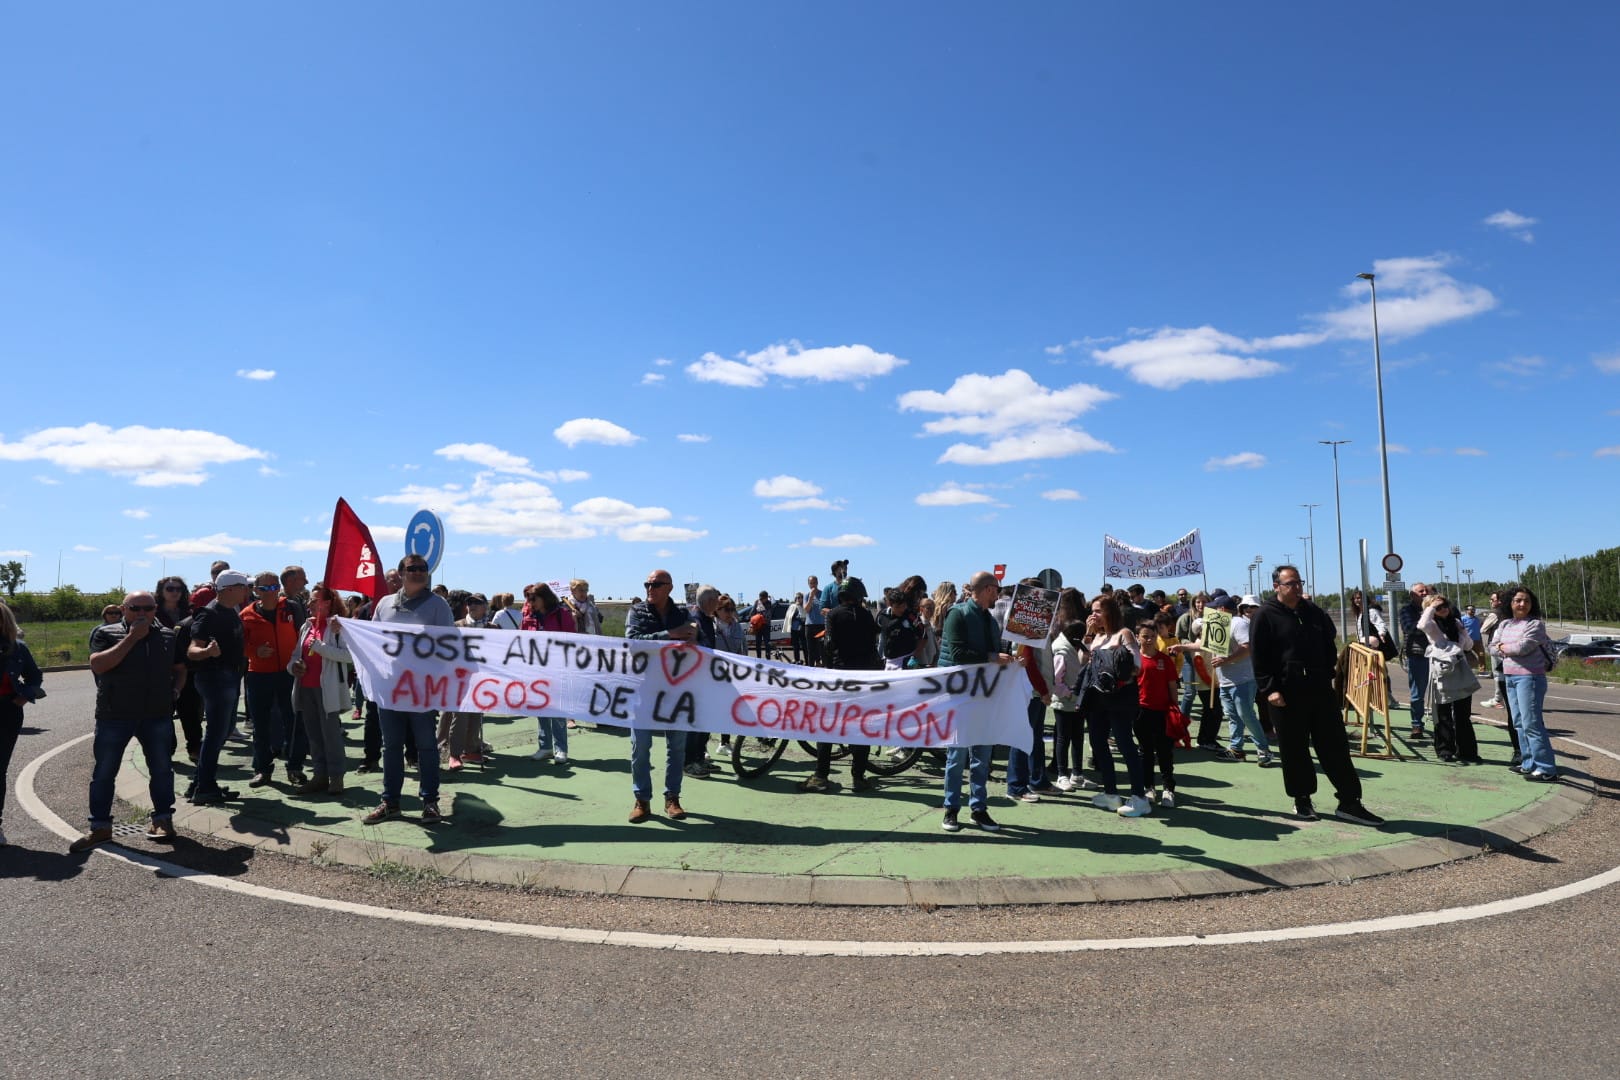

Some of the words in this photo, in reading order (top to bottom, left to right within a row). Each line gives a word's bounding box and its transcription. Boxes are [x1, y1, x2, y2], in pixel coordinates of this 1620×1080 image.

[1113, 552, 1134, 567] NOS
[1138, 547, 1193, 569] SACRIFICAN
[1157, 565, 1181, 577] SUR
[382, 630, 487, 663] JOSE
[672, 650, 687, 677] Y
[918, 664, 1007, 698] SON
[589, 683, 635, 719] DE
[653, 691, 695, 724] LA
